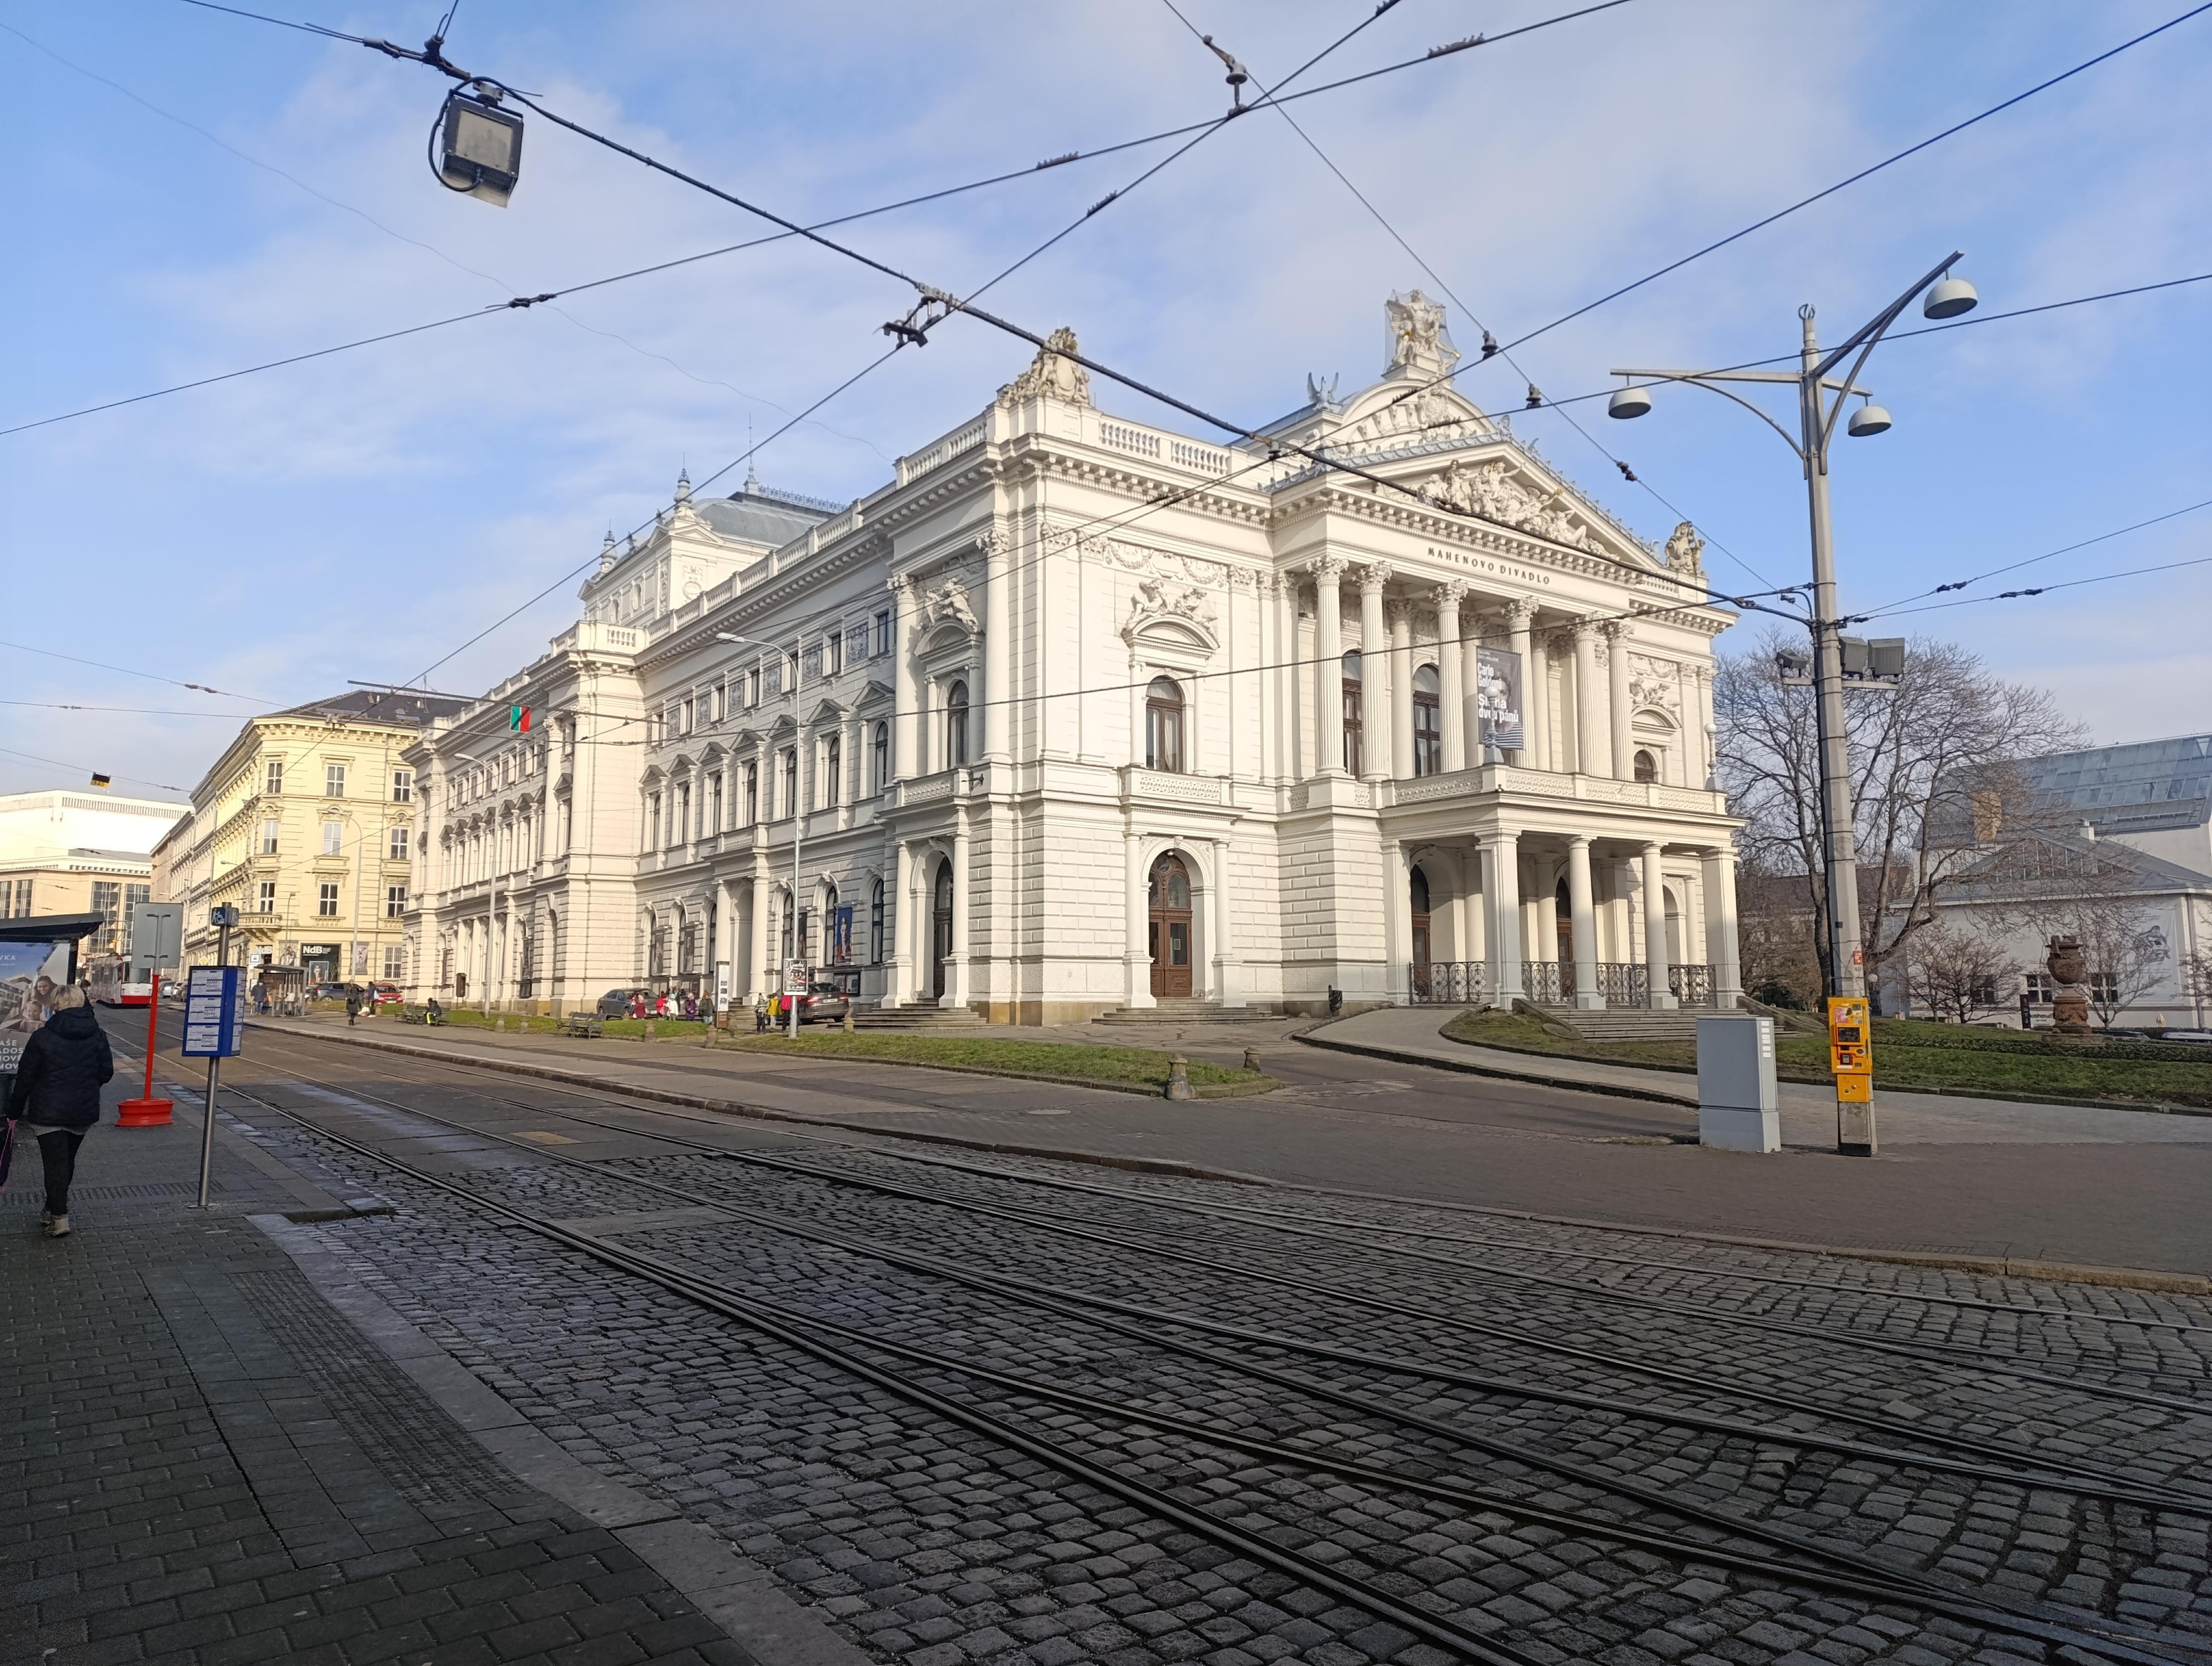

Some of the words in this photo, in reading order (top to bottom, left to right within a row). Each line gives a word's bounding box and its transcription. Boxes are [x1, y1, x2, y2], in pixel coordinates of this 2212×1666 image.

[1427, 547, 1494, 571] MAHENOVO
[1500, 565, 1550, 585] DIVADLO
[1477, 663, 1494, 677] Carlo
[1479, 693, 1507, 709] Slha
[1499, 709, 1519, 724] pánů
